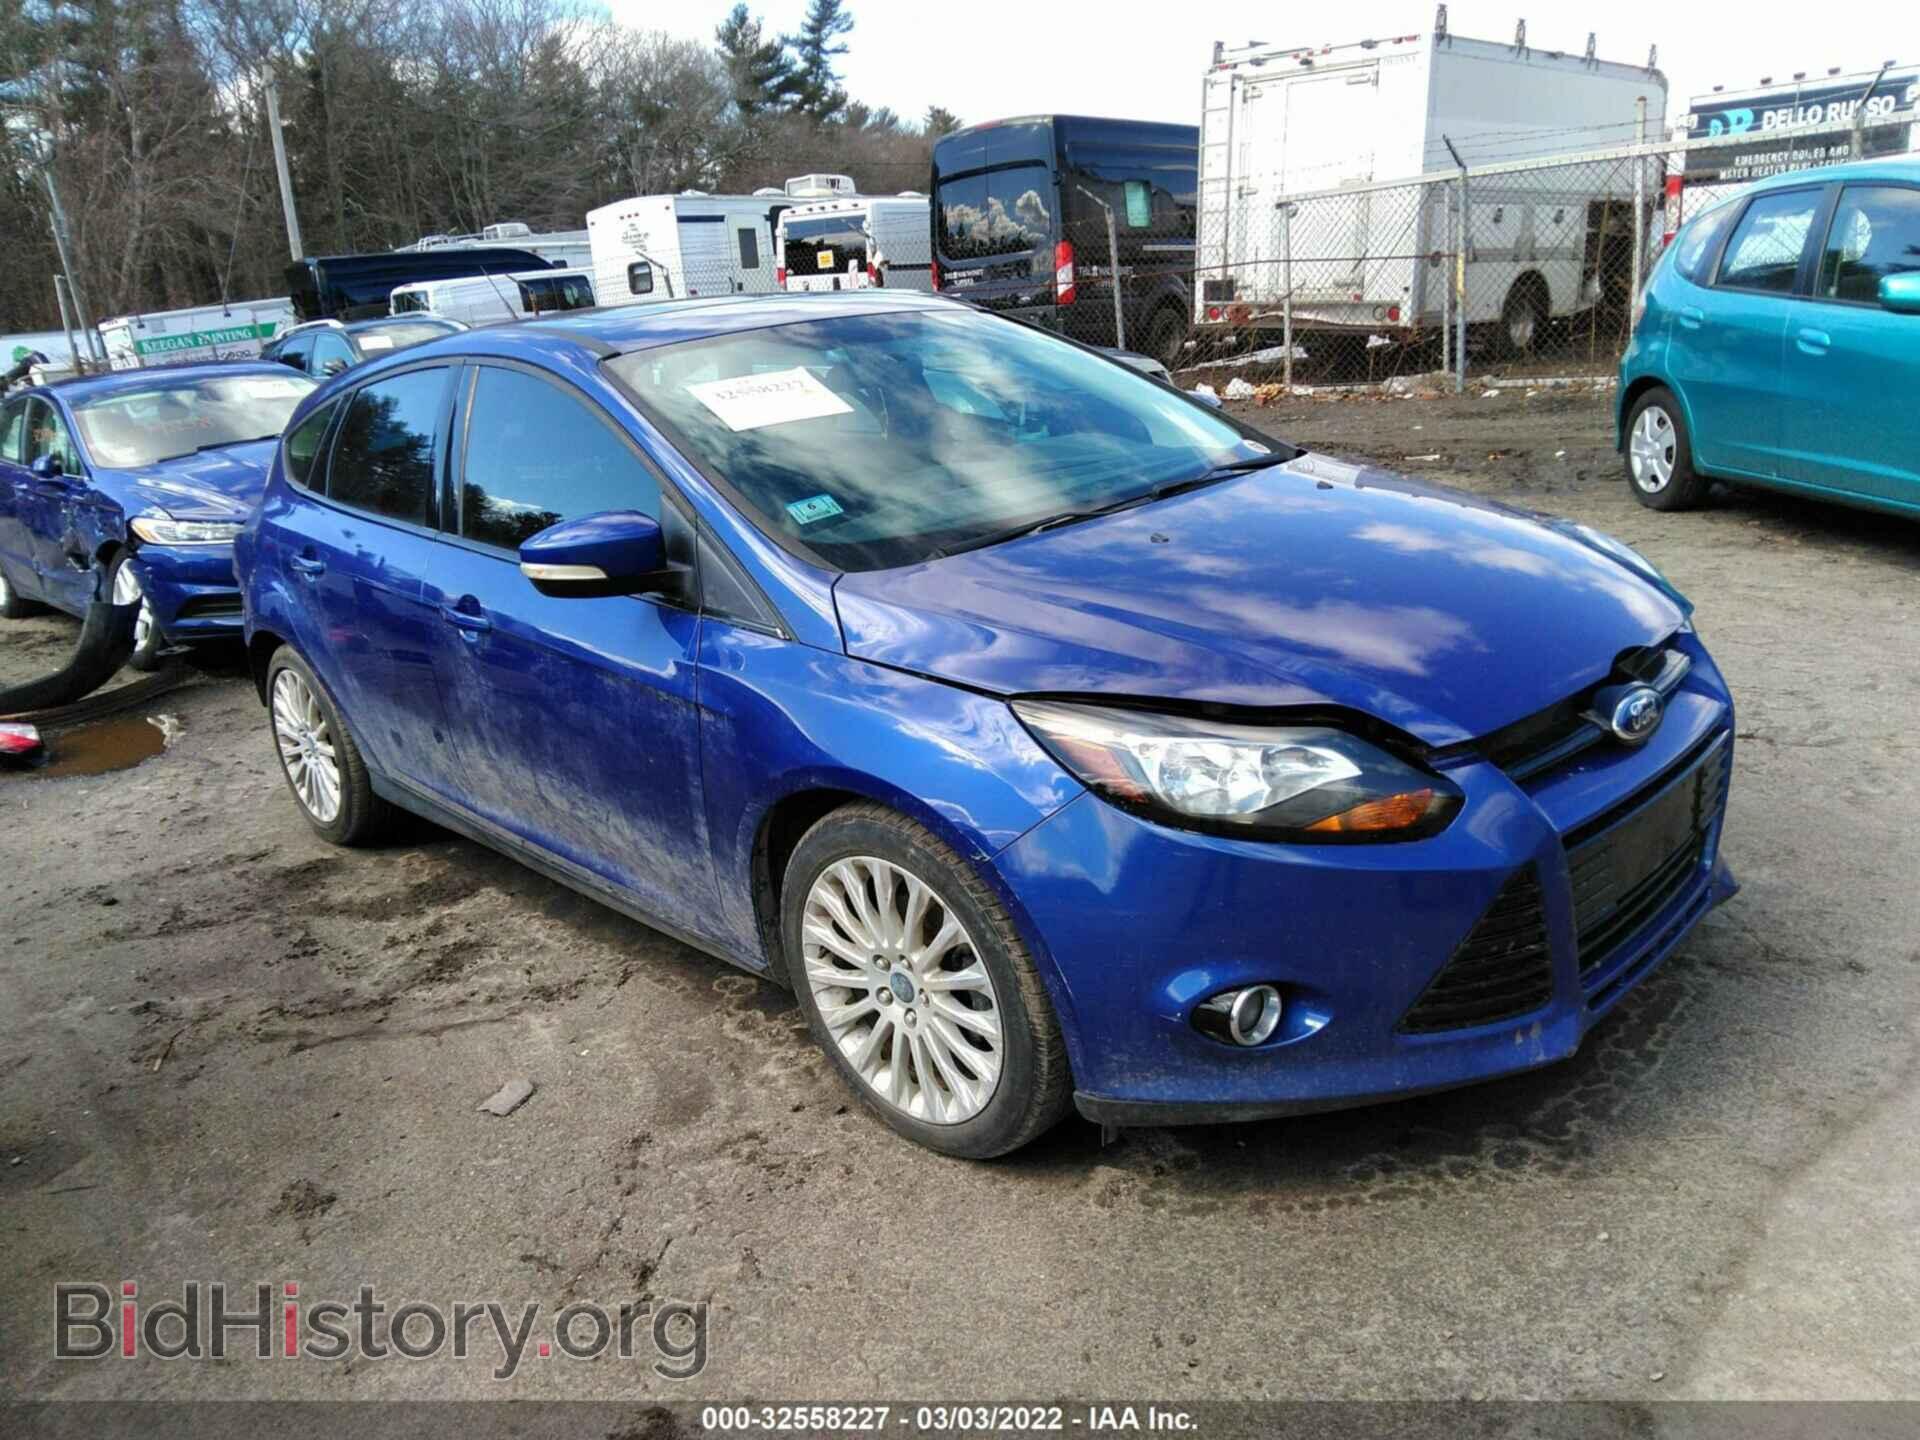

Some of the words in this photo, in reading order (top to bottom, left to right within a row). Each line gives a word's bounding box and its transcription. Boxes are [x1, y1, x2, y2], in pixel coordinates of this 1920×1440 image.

[1762, 104, 1823, 130] DELLO
[1735, 151, 1789, 166] EMERGENCY
[142, 336, 194, 353] KEEGAN
[197, 328, 252, 346] PAINTING
